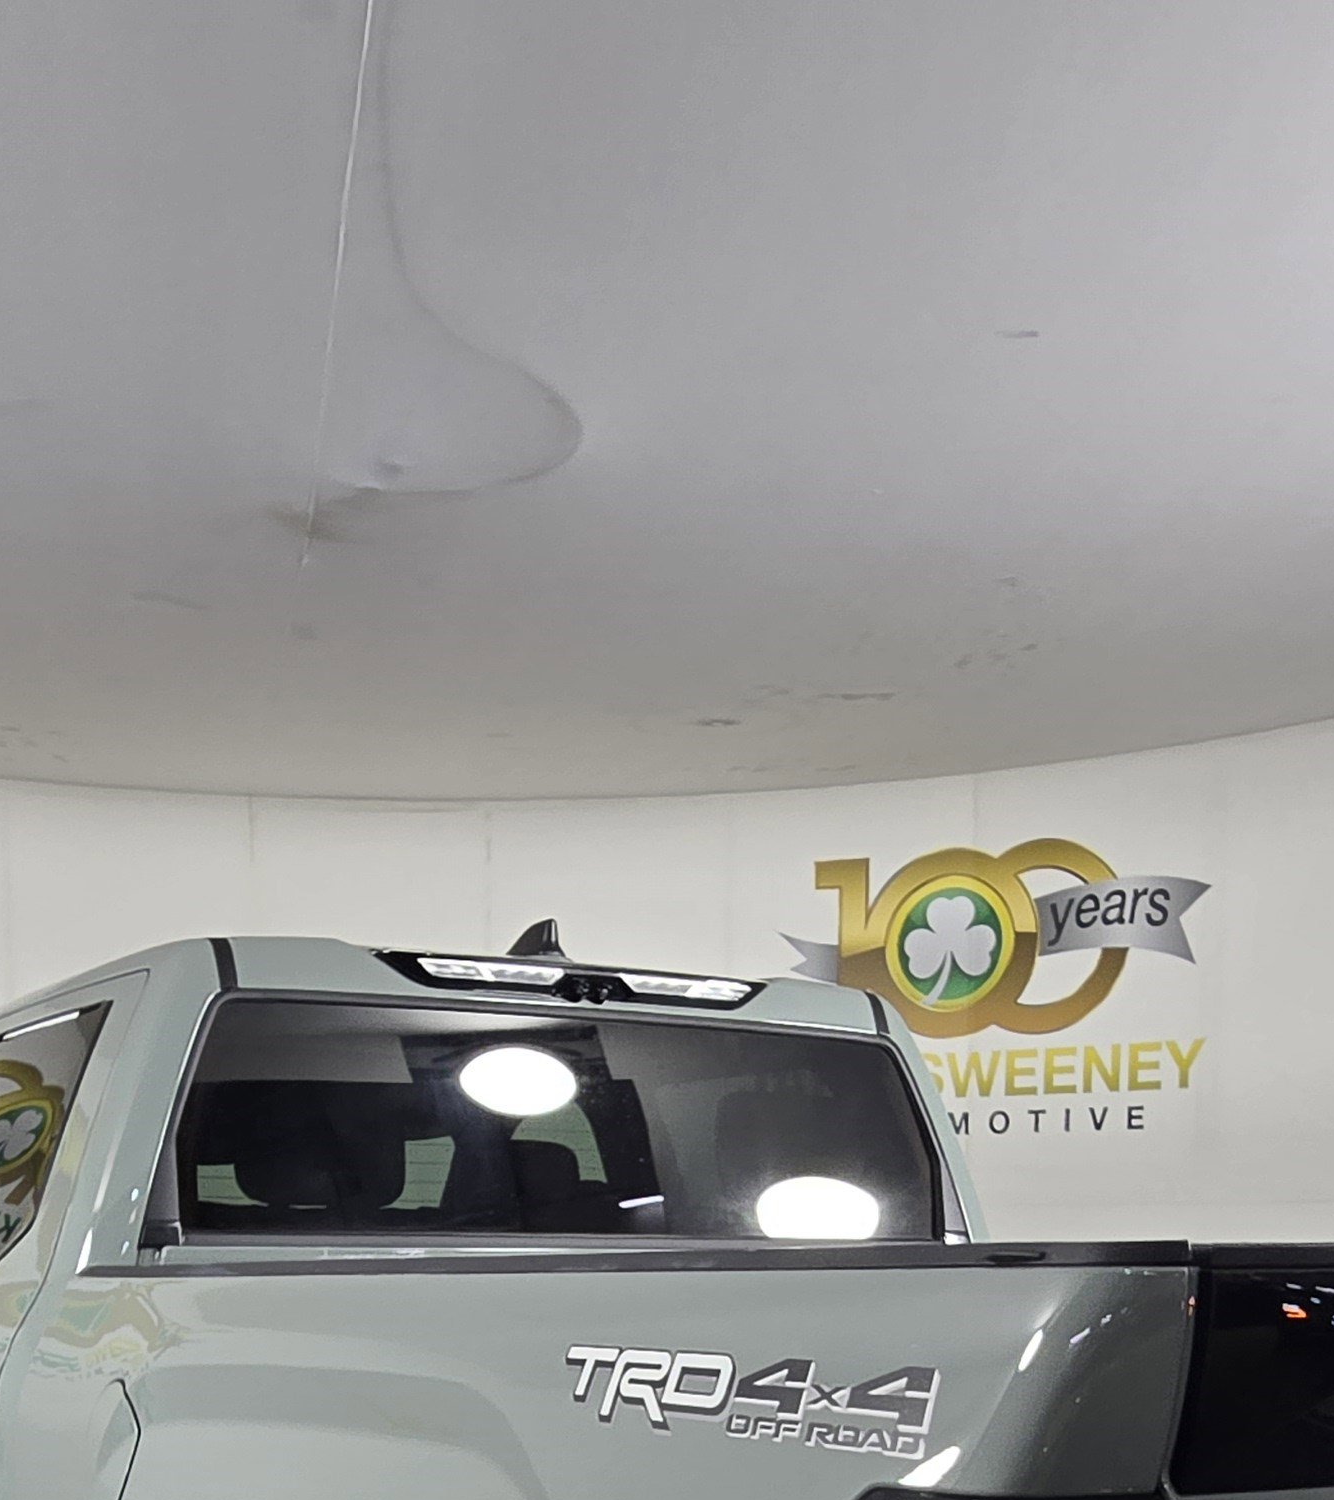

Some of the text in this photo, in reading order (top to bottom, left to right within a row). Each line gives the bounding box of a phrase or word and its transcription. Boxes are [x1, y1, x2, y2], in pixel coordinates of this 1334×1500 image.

[1047, 885, 1171, 946] years
[948, 1106, 1146, 1134] MOTIVE
[566, 1344, 736, 1436] TRD
[725, 1412, 926, 1461] OFF ROAD
